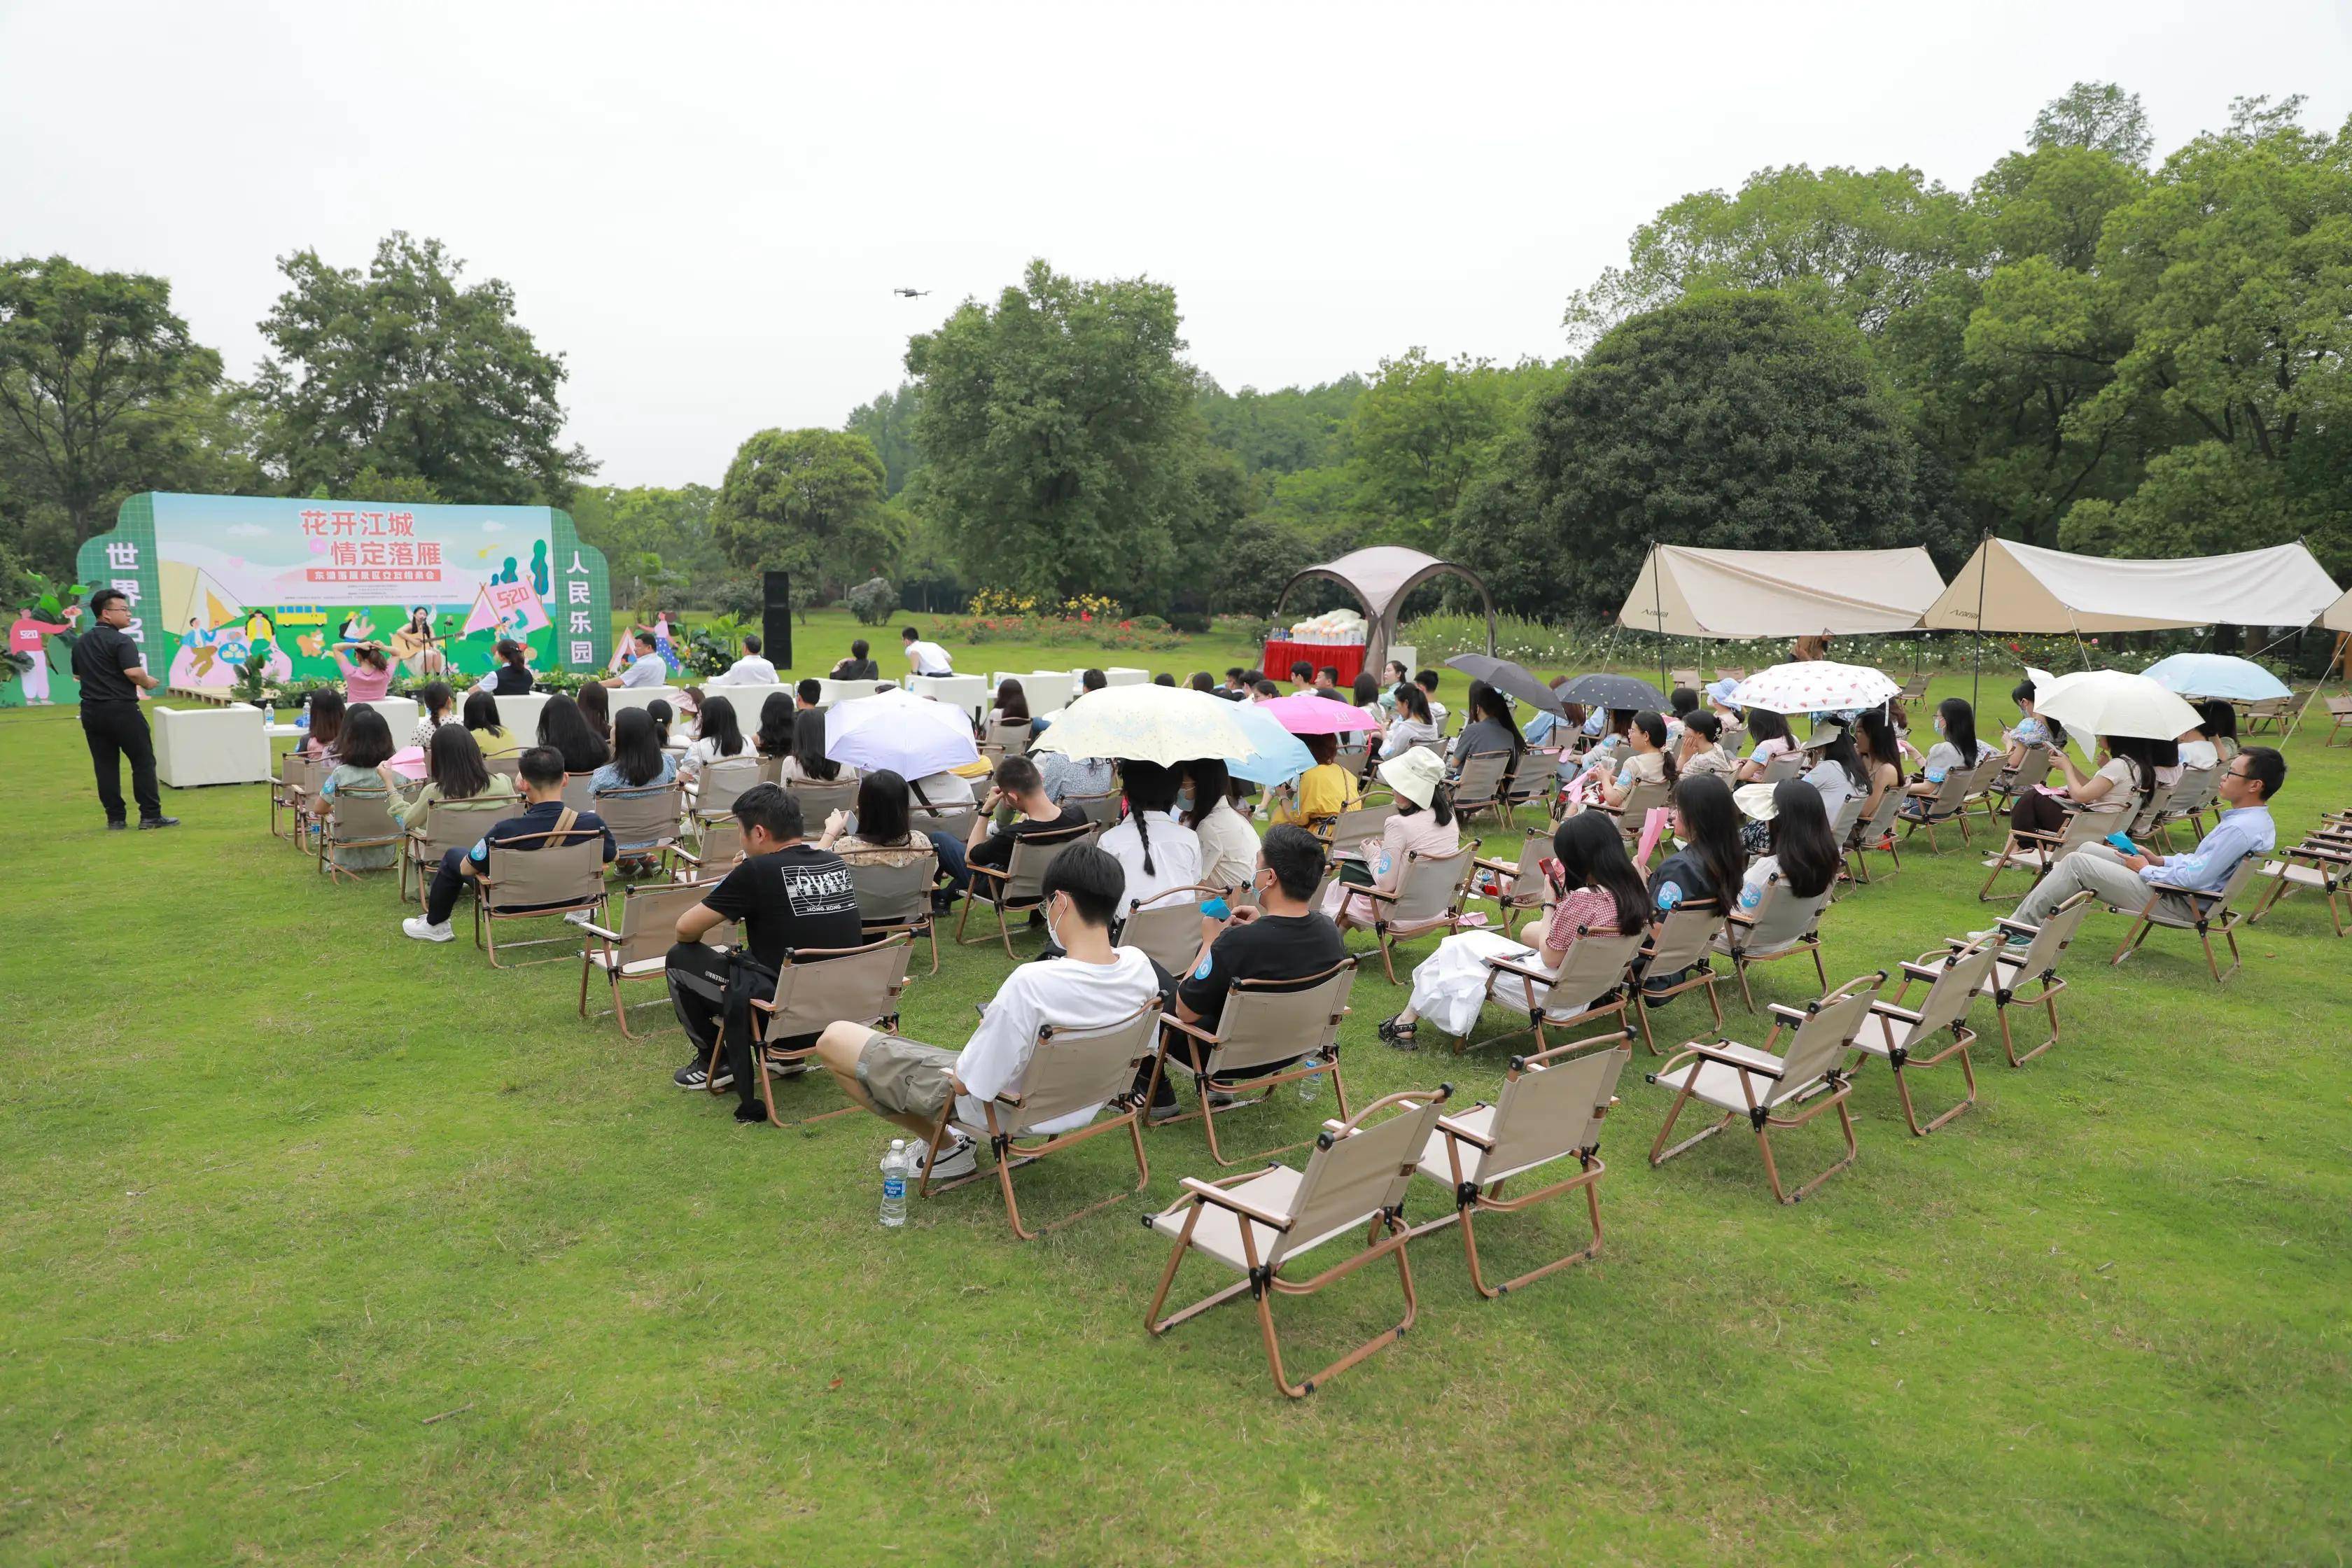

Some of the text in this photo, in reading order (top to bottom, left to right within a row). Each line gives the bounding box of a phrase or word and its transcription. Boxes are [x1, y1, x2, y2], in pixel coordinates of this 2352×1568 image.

[300, 510, 414, 537] 花开江城
[330, 541, 442, 566] 情定落雁
[106, 542, 148, 677] 世界名
[496, 587, 529, 609] 520
[566, 550, 593, 664] 人民乐园
